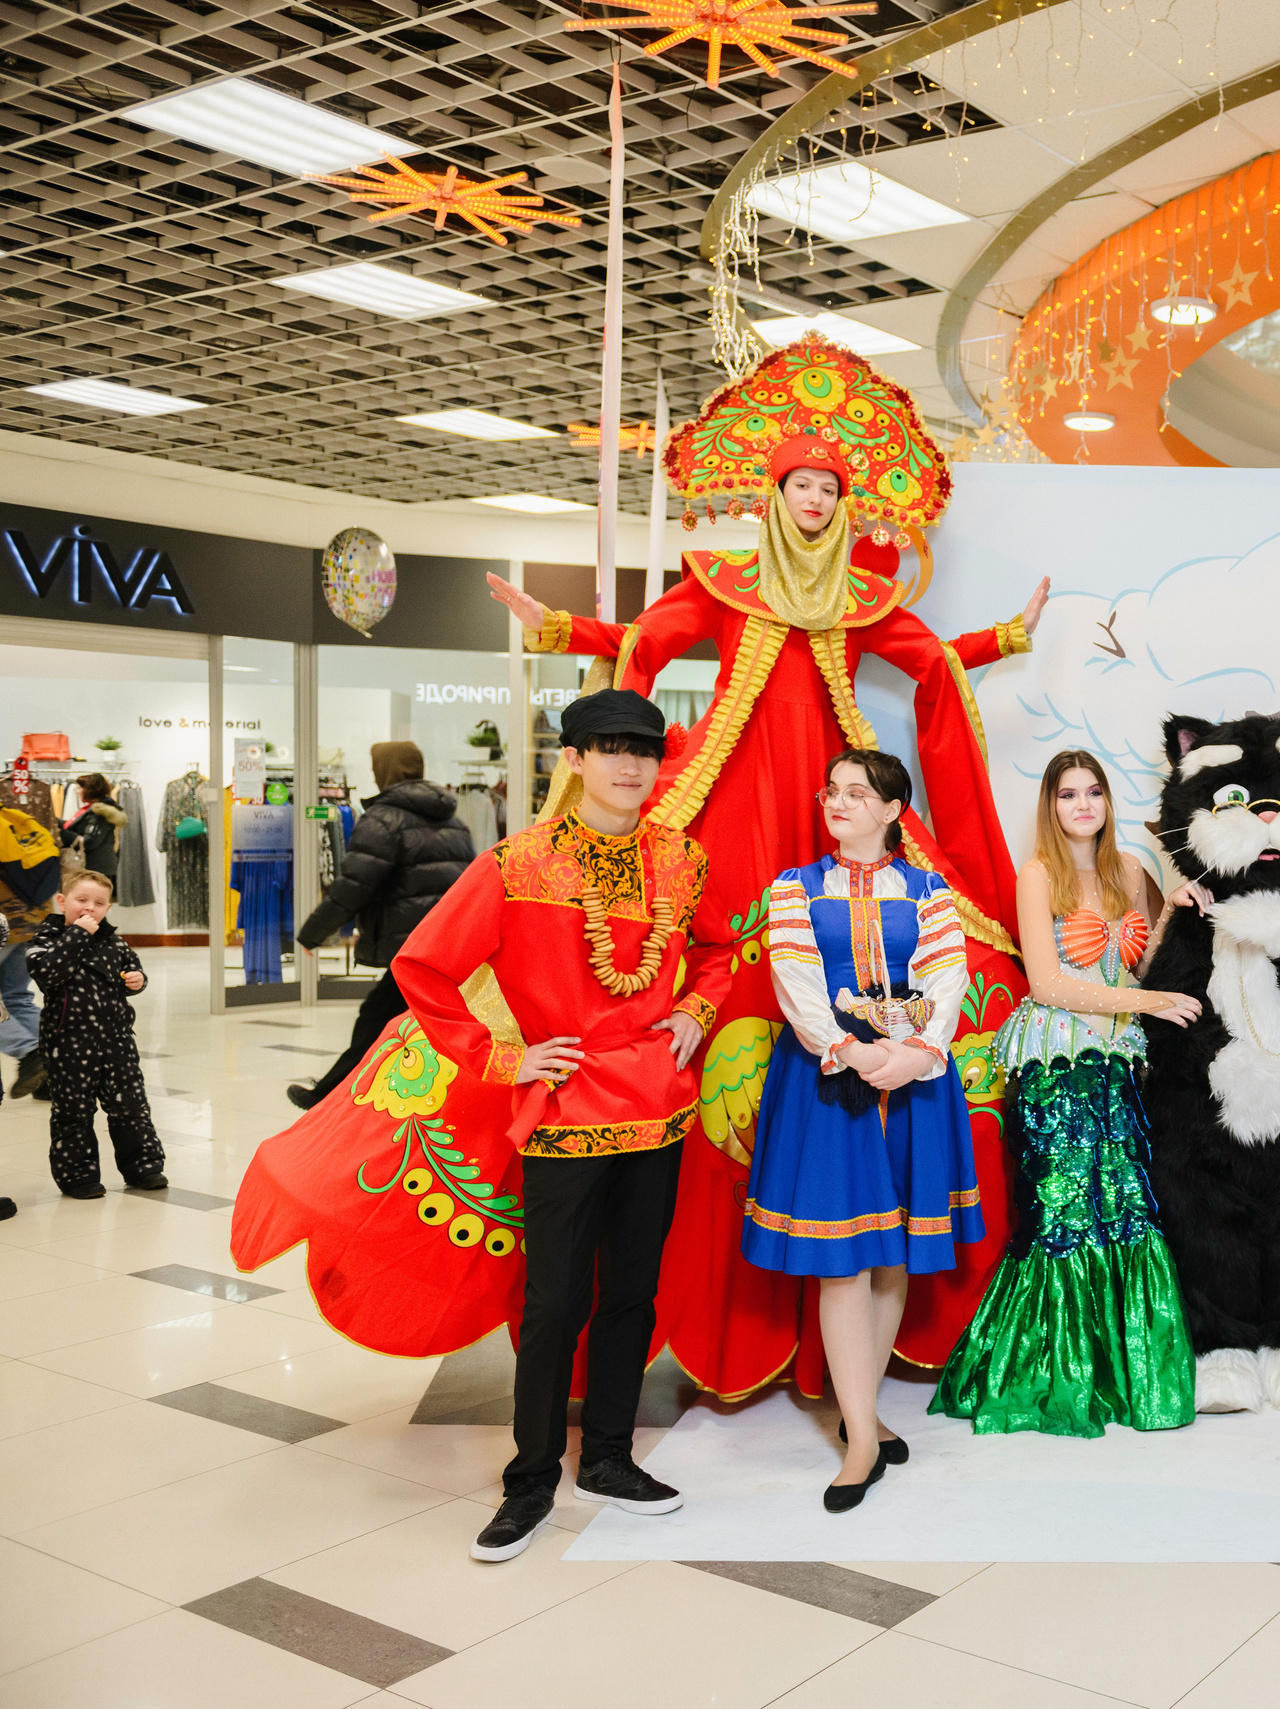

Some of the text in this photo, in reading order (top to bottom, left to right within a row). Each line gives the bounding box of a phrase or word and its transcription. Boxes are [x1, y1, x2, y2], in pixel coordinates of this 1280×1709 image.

[139, 716, 261, 730] love & merial
[238, 761, 263, 772] 50%
[13, 769, 29, 779] 50
[13, 780, 29, 793] %
